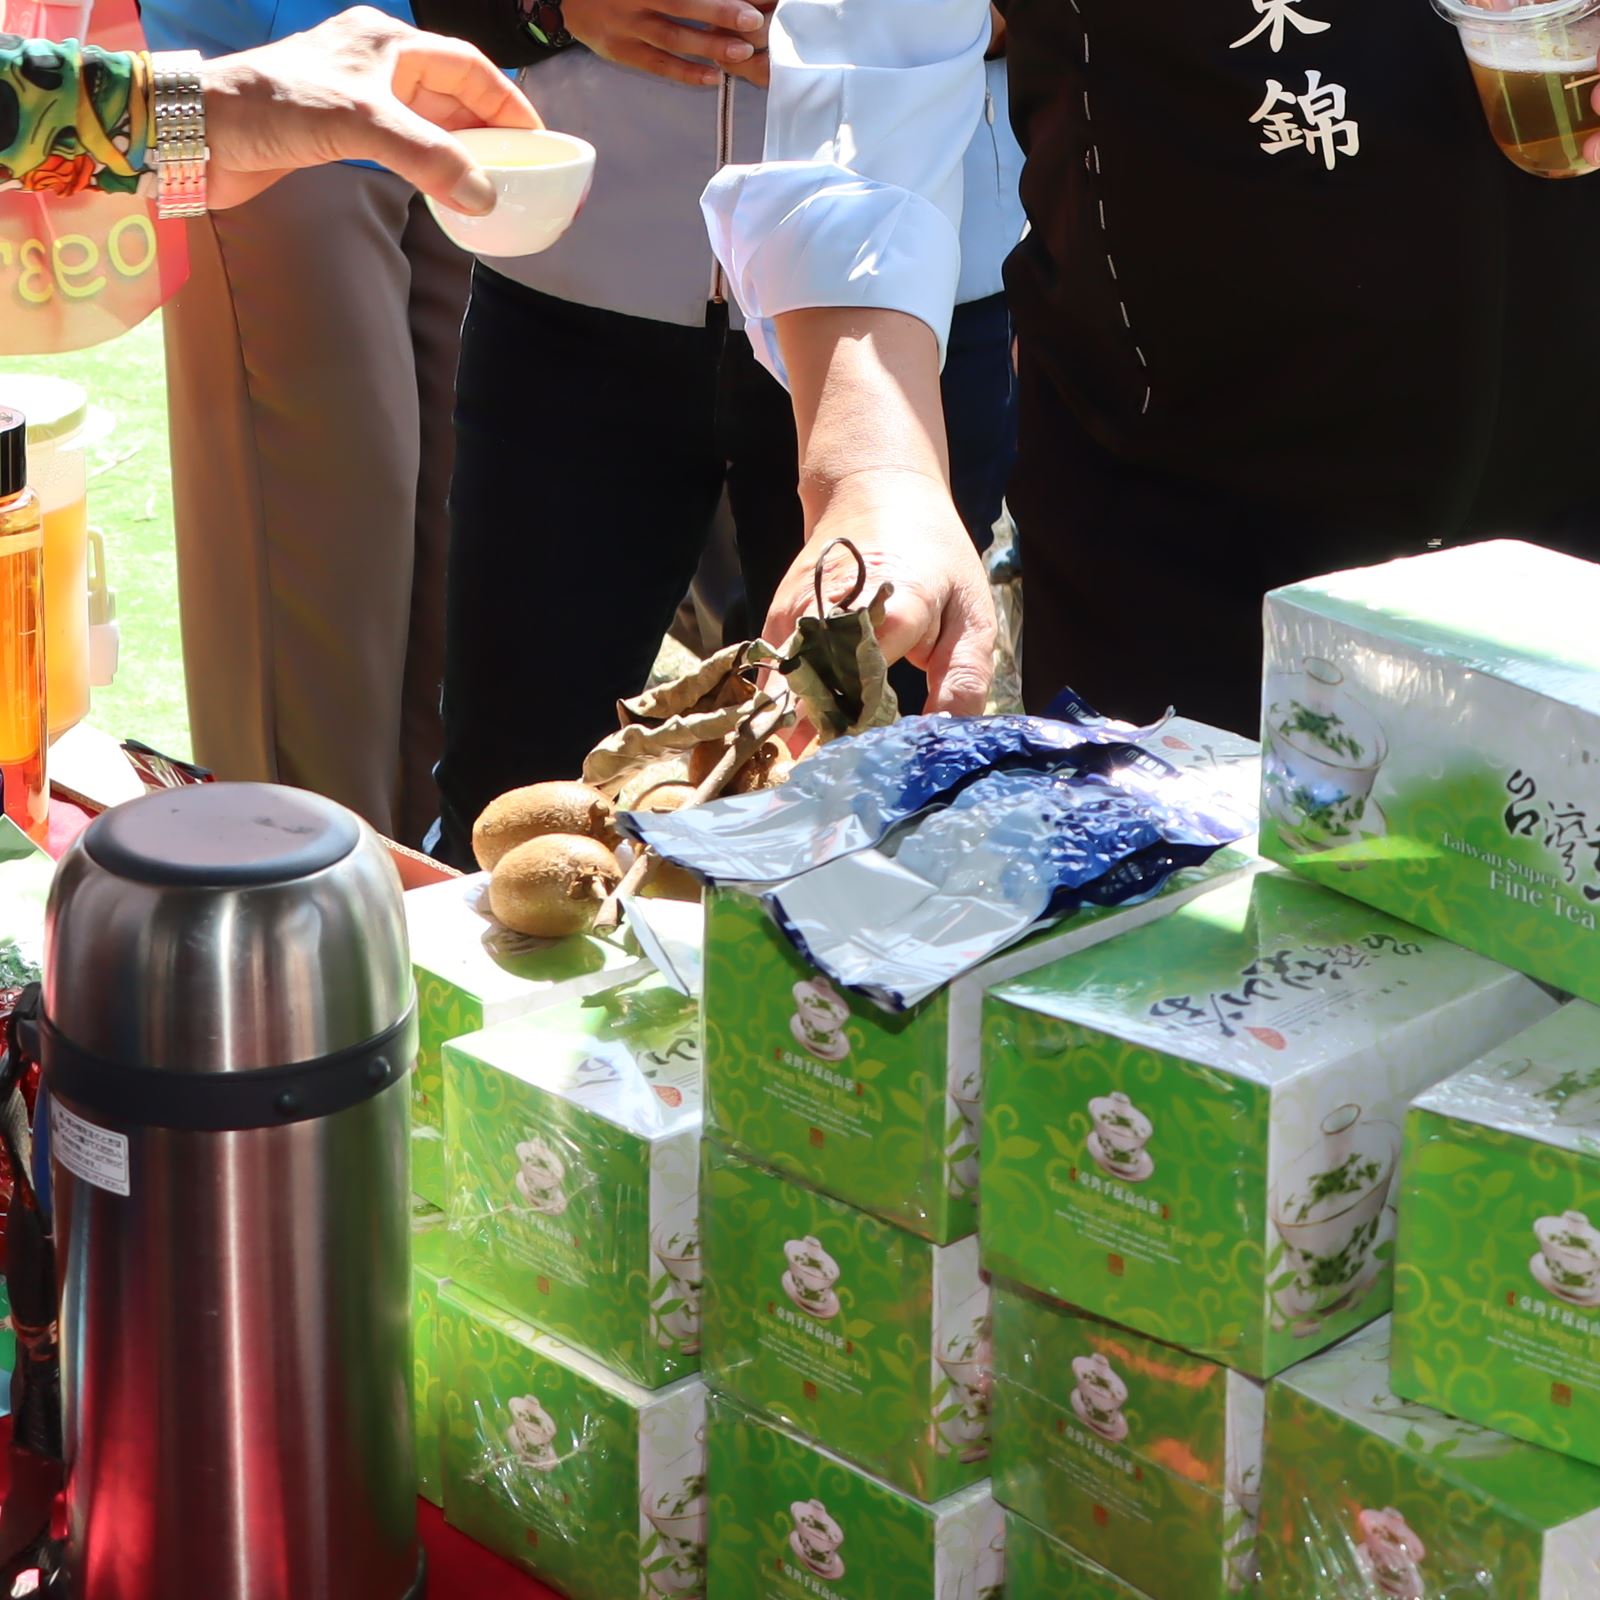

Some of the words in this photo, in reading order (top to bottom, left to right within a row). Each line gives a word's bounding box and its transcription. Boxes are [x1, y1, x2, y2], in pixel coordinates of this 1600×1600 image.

[1440, 831, 1502, 869] Taiwan
[1505, 855, 1561, 891] Super
[1489, 871, 1545, 908] Fine
[1552, 891, 1598, 931] Tea
